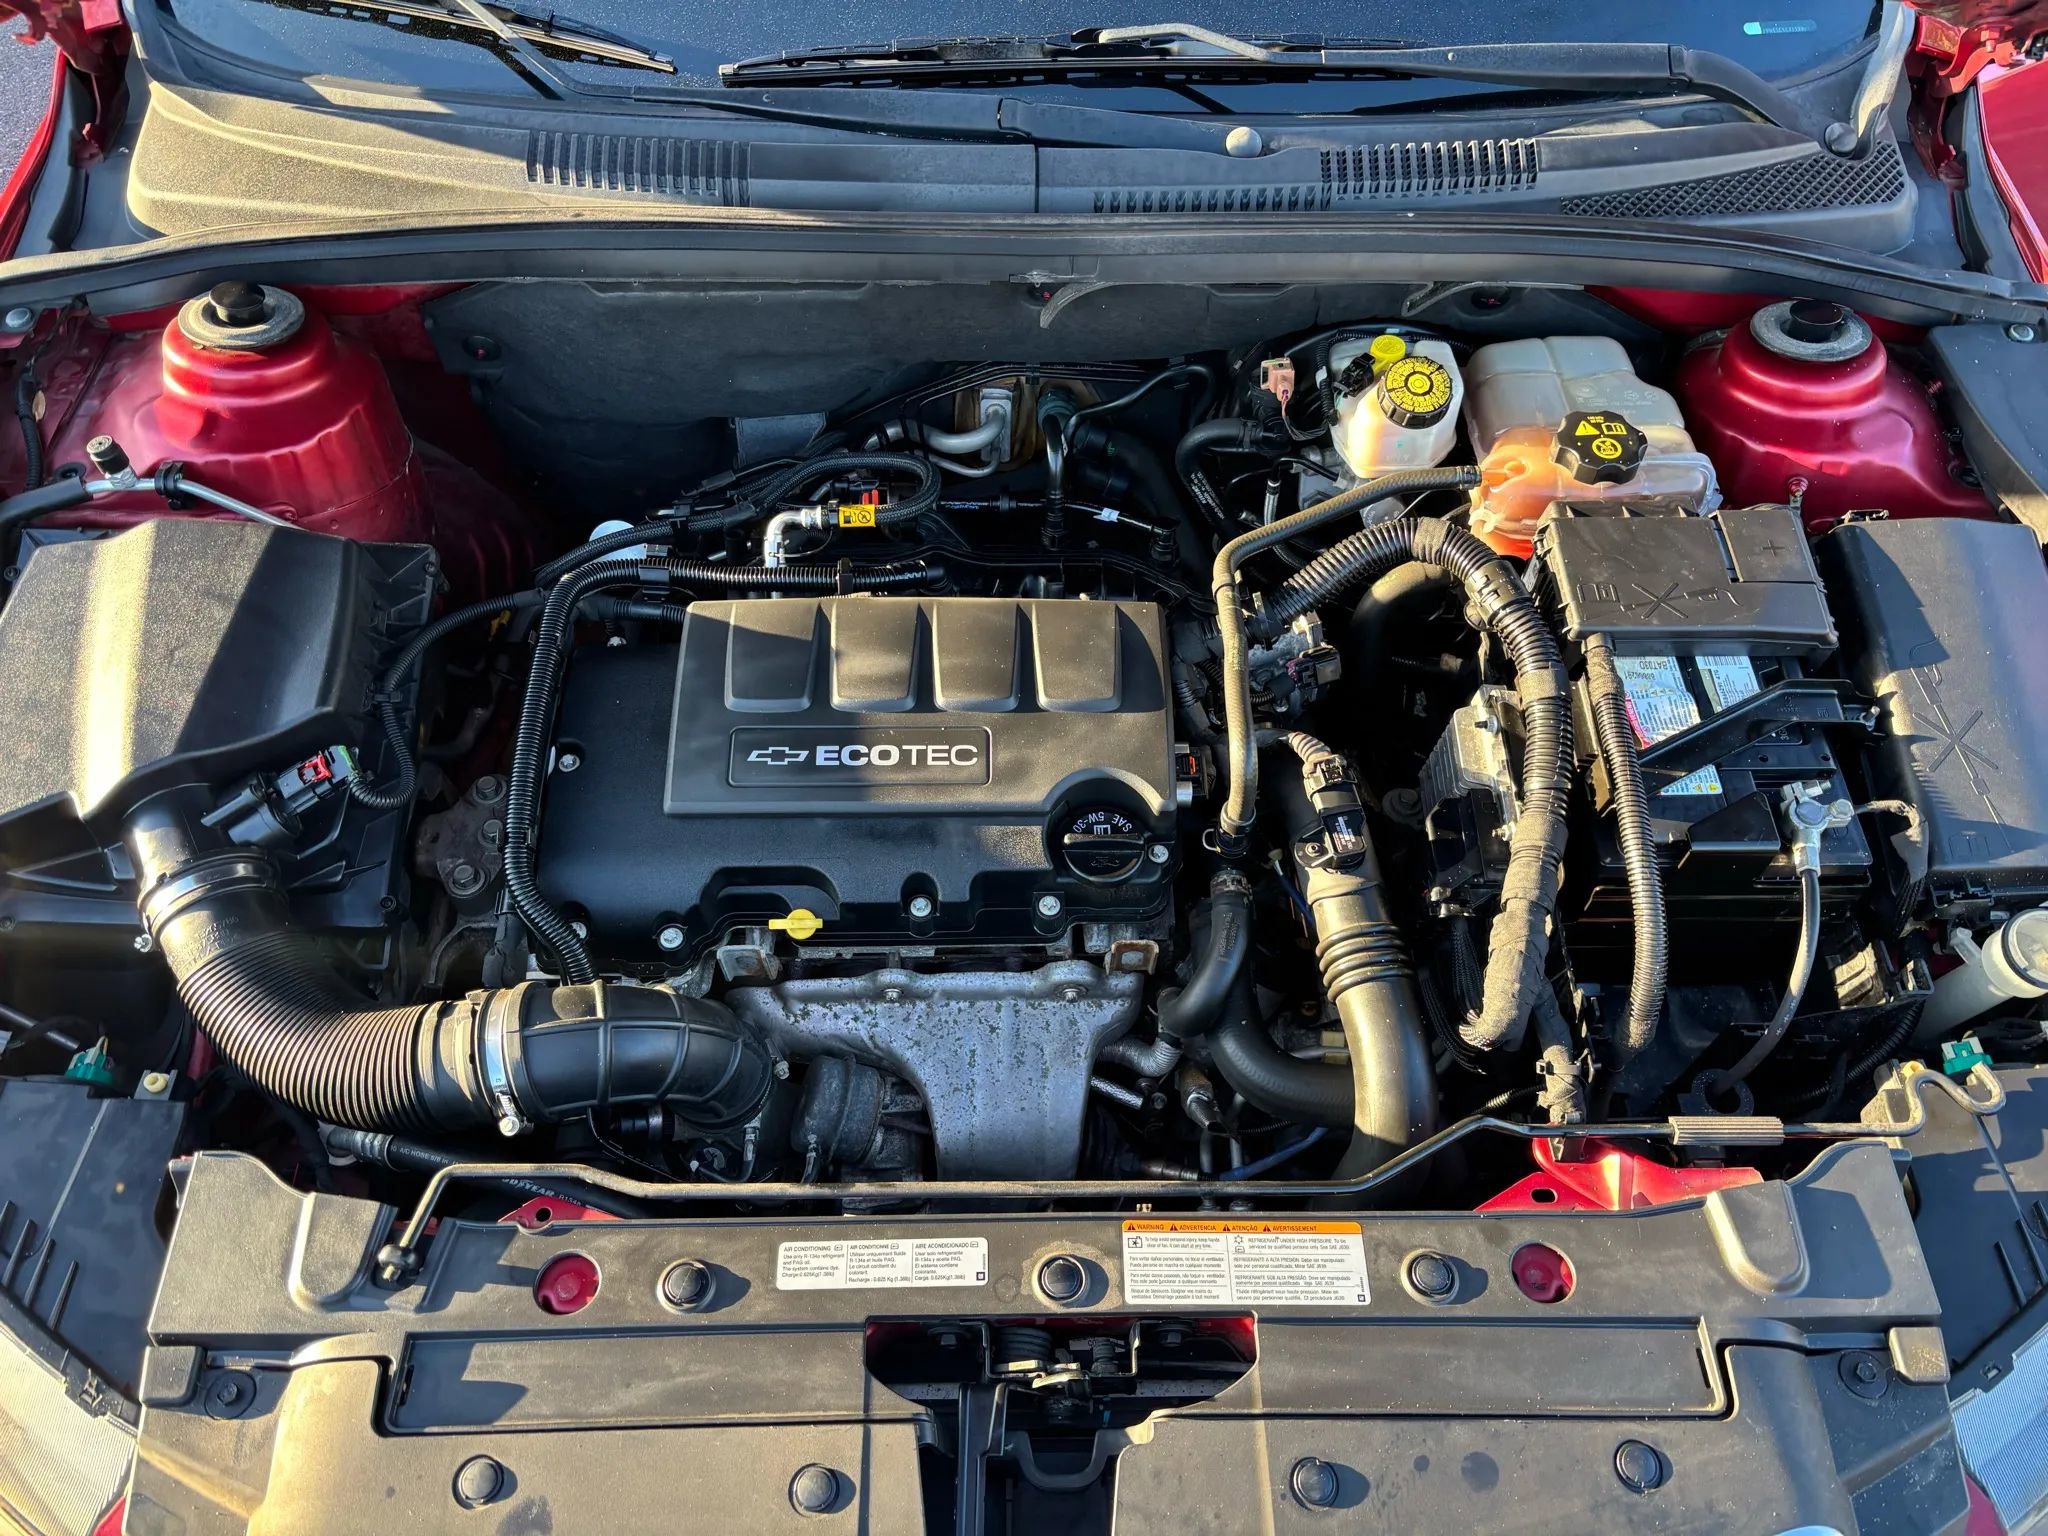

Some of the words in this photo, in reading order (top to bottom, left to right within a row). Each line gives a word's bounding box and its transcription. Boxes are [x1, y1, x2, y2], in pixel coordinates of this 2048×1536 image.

[815, 744, 978, 766] ECOTEC
[1072, 811, 1105, 833] 5W-30
[1111, 814, 1133, 832] SAE
[411, 1150, 429, 1160] HOSE
